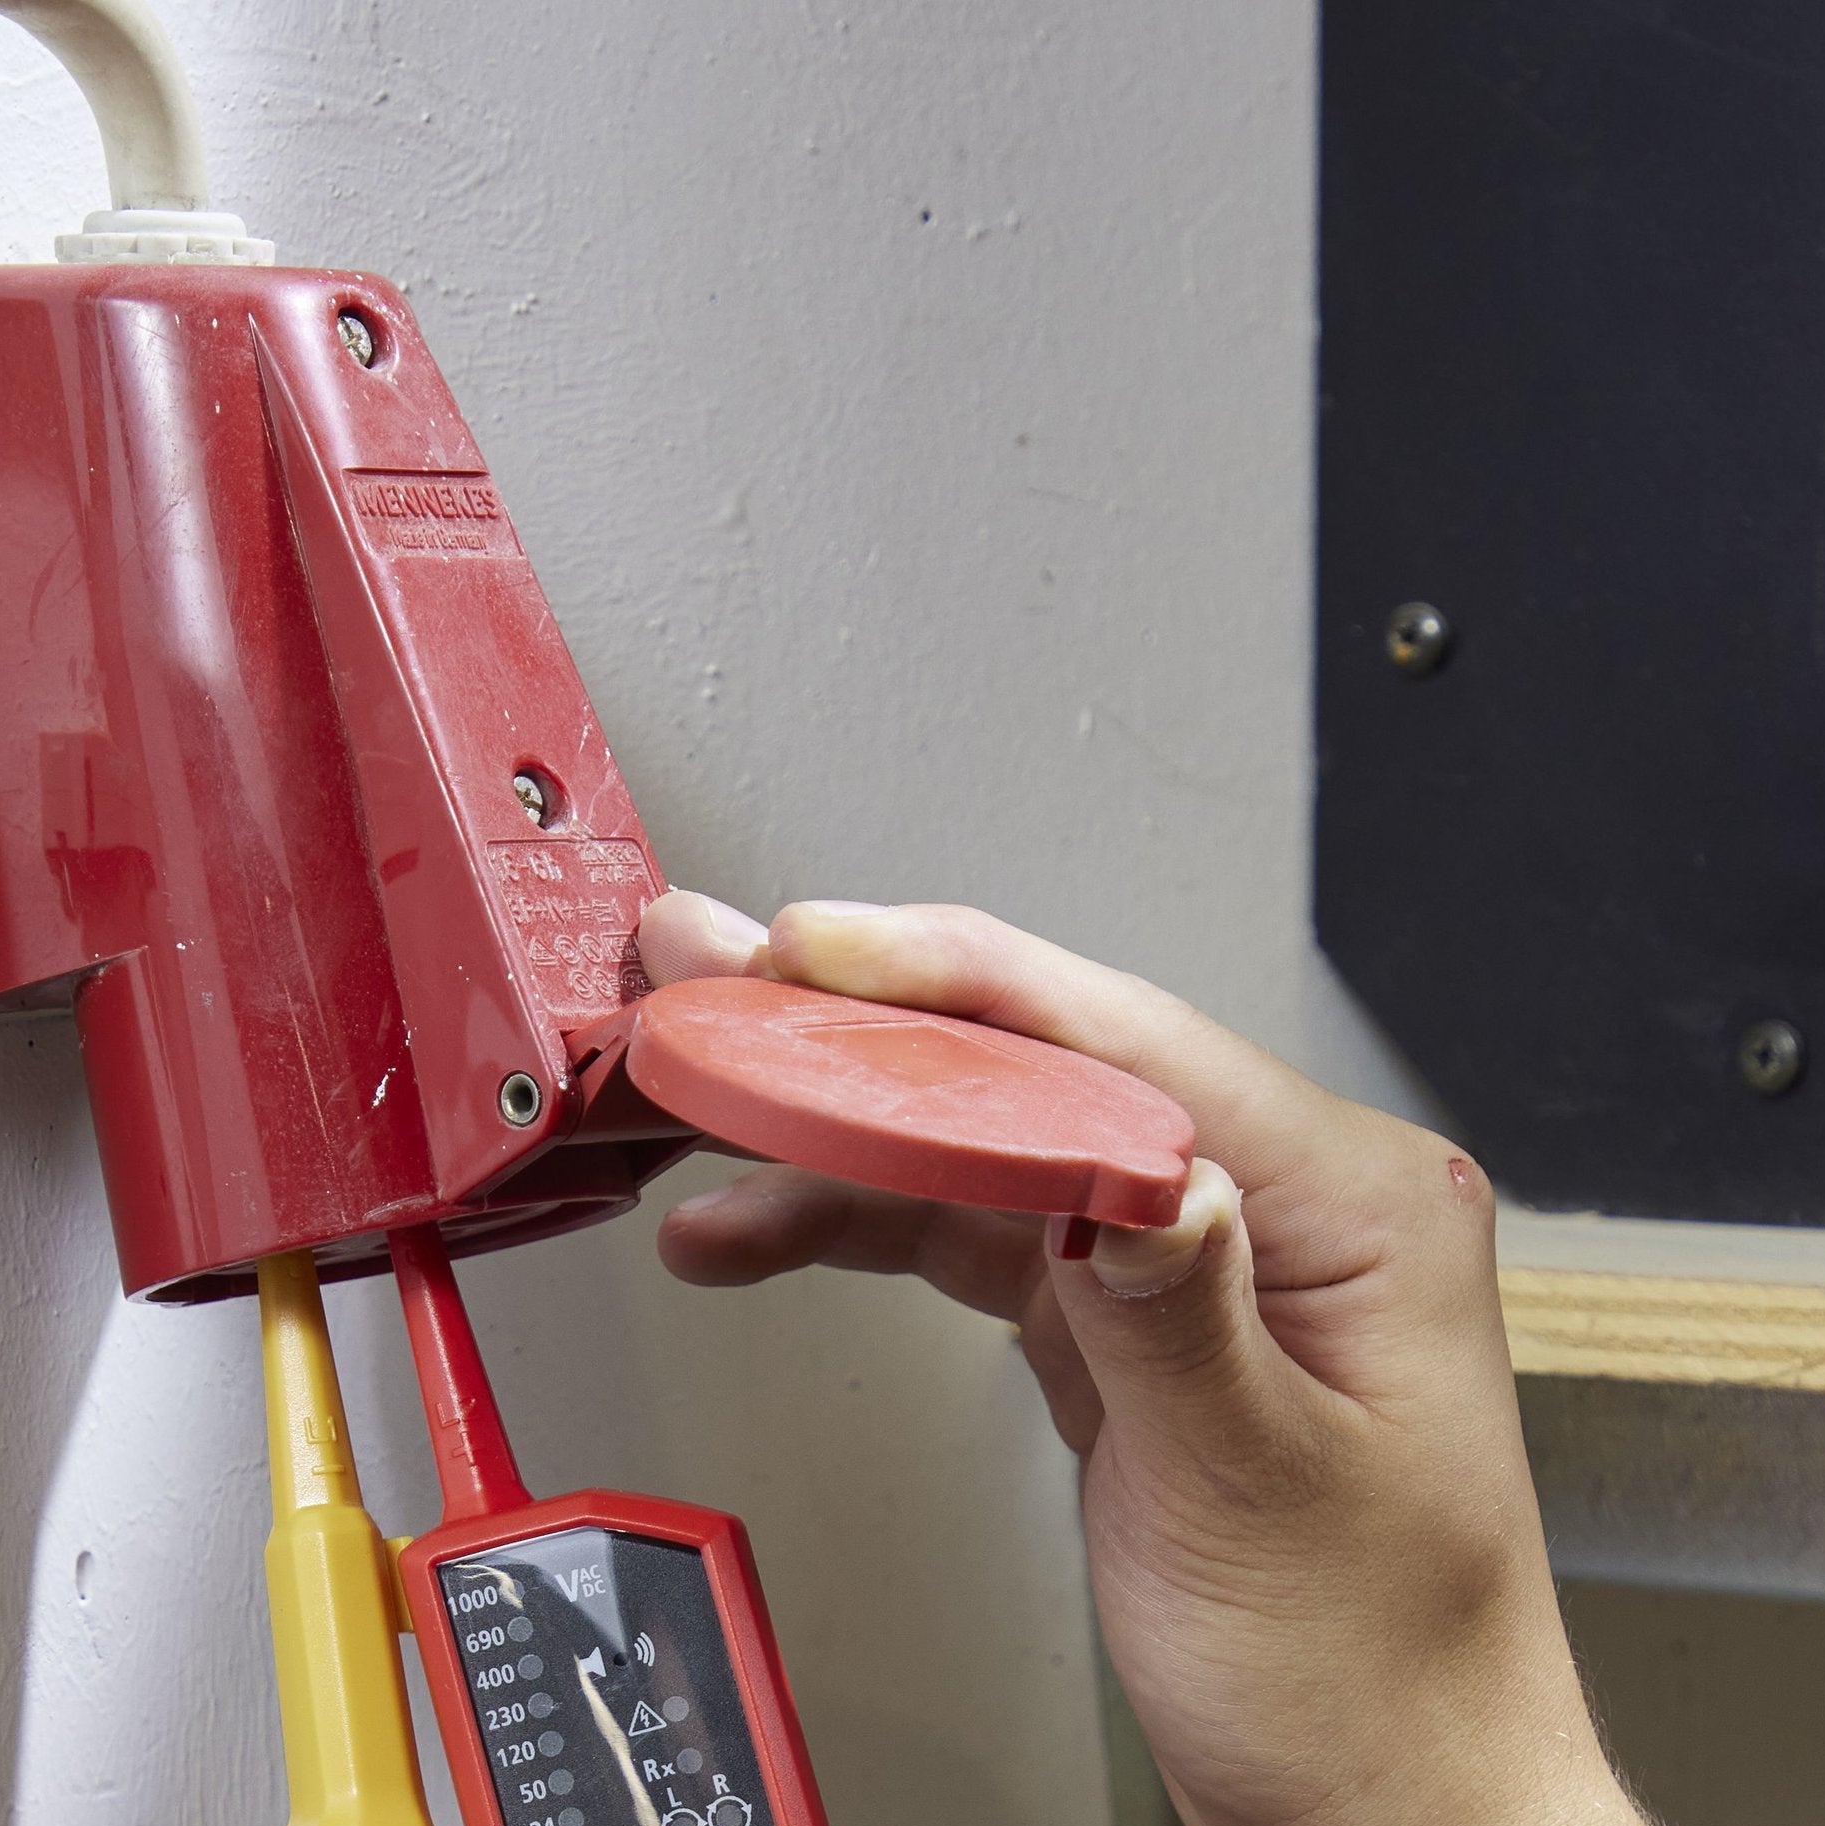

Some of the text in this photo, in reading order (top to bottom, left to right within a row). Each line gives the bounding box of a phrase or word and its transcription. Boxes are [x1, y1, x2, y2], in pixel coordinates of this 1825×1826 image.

[352, 481, 499, 519] MENNEKES
[579, 1564, 602, 1583] AC
[447, 1585, 498, 1616] 1000
[582, 1579, 606, 1598] DC
[466, 1626, 505, 1653] 690
[476, 1663, 515, 1690] 400
[485, 1702, 525, 1731] 230
[496, 1740, 536, 1768] 120
[642, 1758, 676, 1783] Rx
[519, 1779, 547, 1804] 50
[666, 1786, 683, 1808] L
[712, 1773, 731, 1796] R
